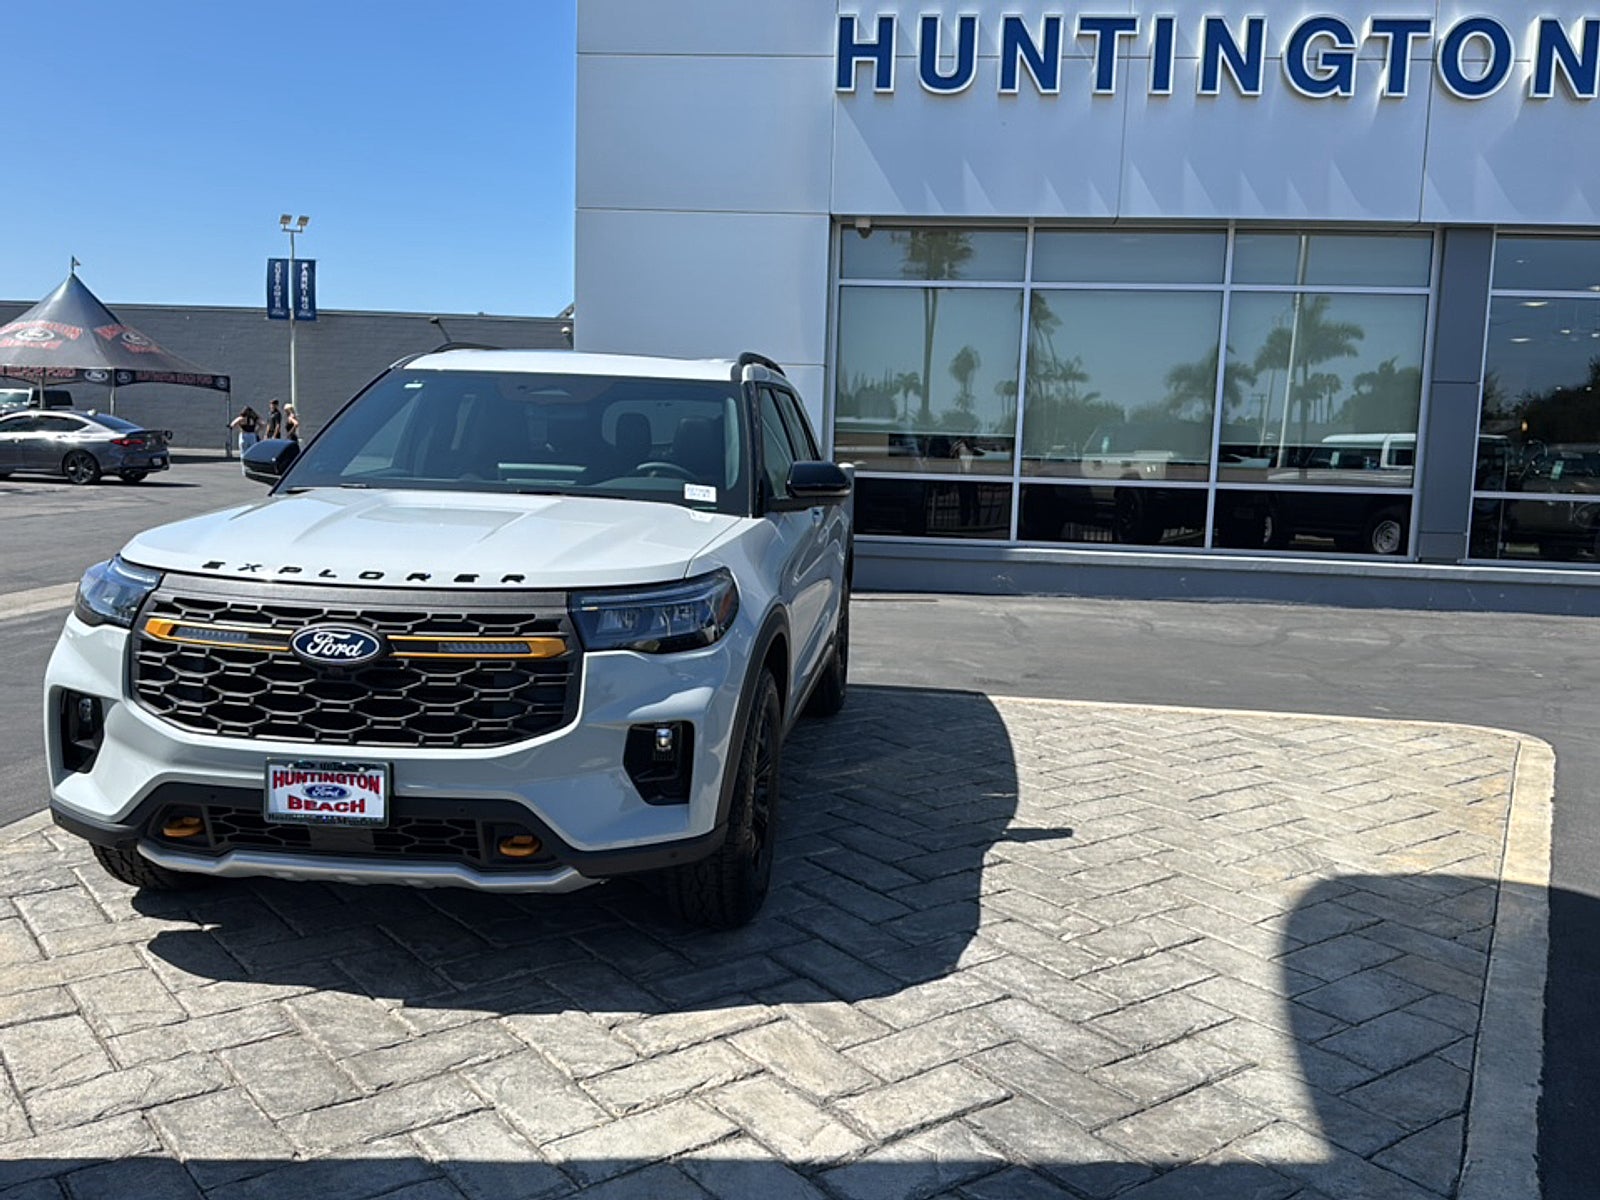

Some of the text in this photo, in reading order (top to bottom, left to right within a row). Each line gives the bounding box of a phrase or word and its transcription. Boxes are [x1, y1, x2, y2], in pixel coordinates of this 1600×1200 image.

[836, 13, 1600, 98] HUNTINGTON
[301, 262, 309, 310] PARKING
[201, 559, 526, 584] EXPLORER
[306, 630, 365, 658] Ford
[272, 769, 381, 795] HUNTINGTON
[311, 784, 341, 798] Ford
[287, 794, 366, 813] BEACH
